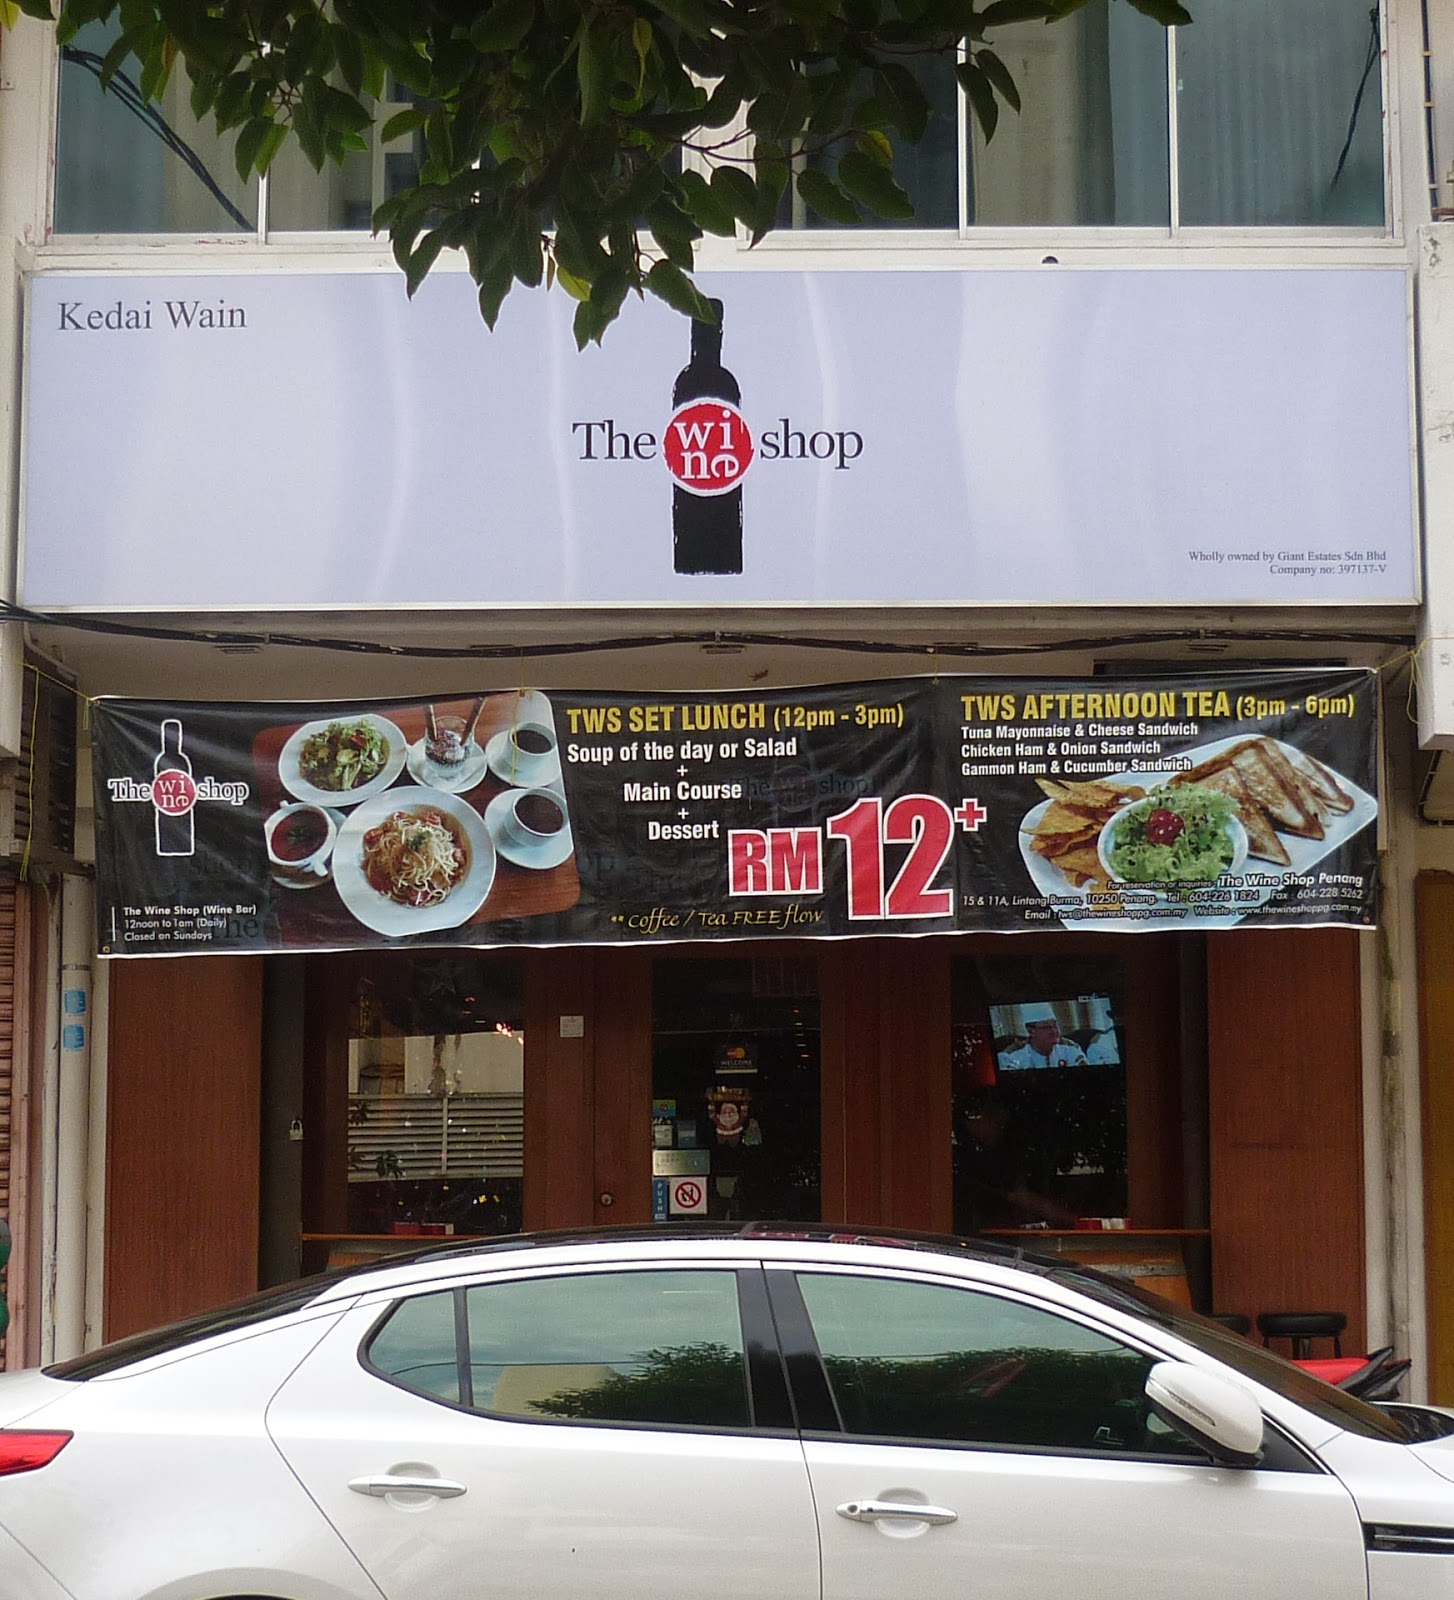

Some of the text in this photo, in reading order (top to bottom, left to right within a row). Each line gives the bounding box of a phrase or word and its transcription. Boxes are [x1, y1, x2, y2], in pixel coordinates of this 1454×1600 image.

[57, 299, 248, 331] Kedai Wain
[572, 419, 657, 460] The
[760, 418, 864, 470] shop
[1188, 551, 1387, 564] Wholly owned by Giant Estates Sdn Bhd
[1269, 564, 1387, 577] Company no: 397137-V
[960, 694, 1016, 721] TWS
[1022, 692, 1176, 720] AFTERNOON
[1182, 691, 1231, 718] TEA
[1236, 695, 1286, 721] (3pm
[1305, 693, 1355, 719] 6pm)
[567, 707, 622, 735] TWS
[628, 705, 675, 733] SET
[681, 703, 766, 733] LUNCH
[773, 705, 836, 732] (12pm
[854, 703, 905, 729] 3pm)
[961, 721, 1199, 741] Tuna Mayonnaise & Cheese Sandwich
[567, 736, 798, 766] Soup of the day or Salad
[961, 740, 1161, 758] Chicken Ham & Onion Sandwich
[961, 757, 1192, 776] Gammon Ham & Cucumber Sandwich
[107, 777, 151, 801] The
[196, 776, 249, 806] shop
[623, 779, 742, 803] Main Course
[647, 820, 720, 841] Dessert
[1107, 881, 1120, 889] For
[1122, 880, 1167, 890] reservation
[1168, 881, 1176, 889] or
[1219, 874, 1242, 887] The
[1249, 874, 1280, 887] Wine
[1283, 873, 1315, 888] Shop
[1318, 873, 1364, 886] Penang
[963, 895, 975, 906] 15
[977, 895, 985, 906] &
[1012, 894, 1048, 908] Lintang
[1086, 893, 1118, 905] 10250
[1189, 890, 1231, 902] 604-226
[1234, 890, 1260, 901] 1824
[1271, 890, 1288, 900] Fax
[1297, 888, 1338, 899] 604-228
[1340, 888, 1363, 899] 5262
[123, 904, 257, 917] The Wine Shop (Wine Bar)
[698, 910, 729, 926] Tea
[732, 909, 781, 926] FREE
[775, 903, 825, 930] flow
[1024, 909, 1051, 920] Email
[1194, 905, 1230, 916] Website
[124, 918, 160, 929] 12noon
[162, 918, 172, 928] to
[197, 917, 228, 929] (Daily)
[124, 930, 214, 943] Closed on Sundays
